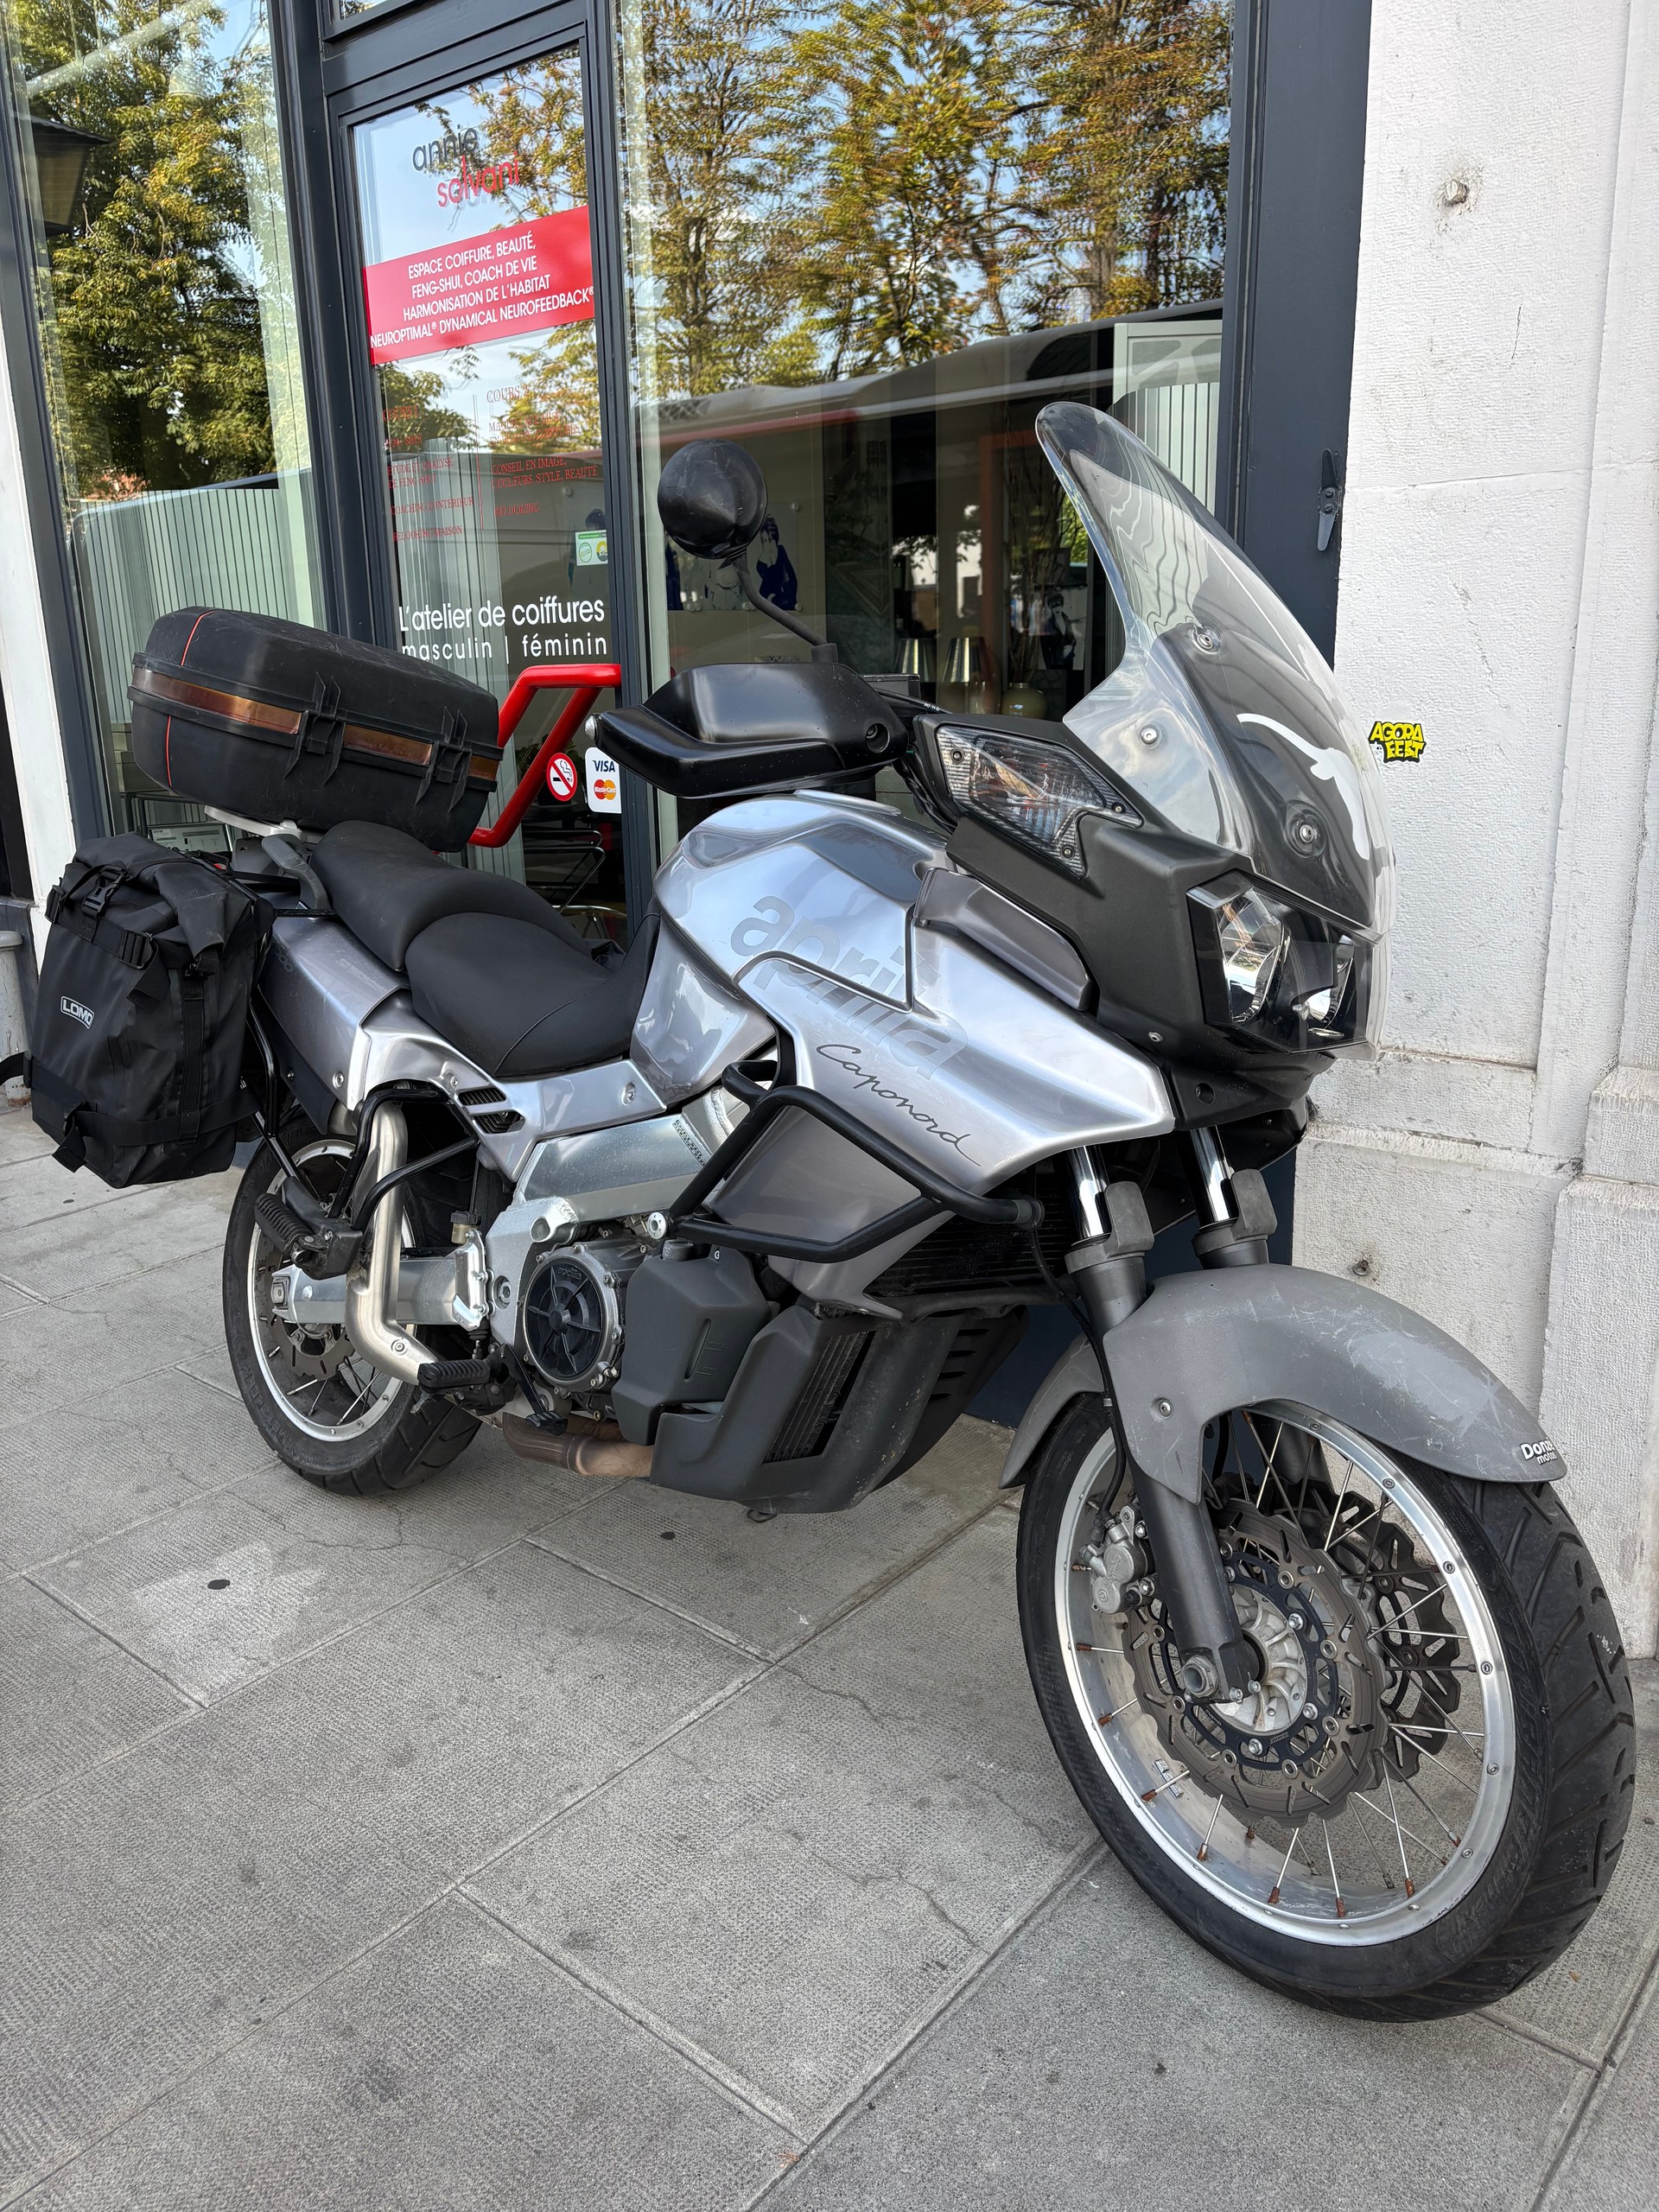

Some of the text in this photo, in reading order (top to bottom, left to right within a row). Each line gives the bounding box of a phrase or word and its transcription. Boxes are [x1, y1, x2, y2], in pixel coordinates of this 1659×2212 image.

[412, 124, 478, 171] annie
[436, 150, 519, 207] solvani
[408, 230, 536, 279] ESPACE COIFFURE, BEAUTÉ,
[411, 256, 537, 299] FENG-SHUI, COACH DE VIE
[403, 274, 550, 321] HARMONISATION DE L'HABITAT
[439, 308, 498, 334] DYNAMICAL
[486, 385, 522, 404] COURS
[525, 459, 536, 471] EN
[398, 595, 605, 632] L'atelier de coiffures
[402, 632, 607, 660] masculin féminin
[1368, 721, 1424, 743] AGORA
[592, 760, 615, 772] VISA
[1384, 740, 1426, 762] FEST
[731, 896, 969, 1081] aprilia
[62, 999, 93, 1026] LOMO
[816, 1044, 982, 1167] Caponord
